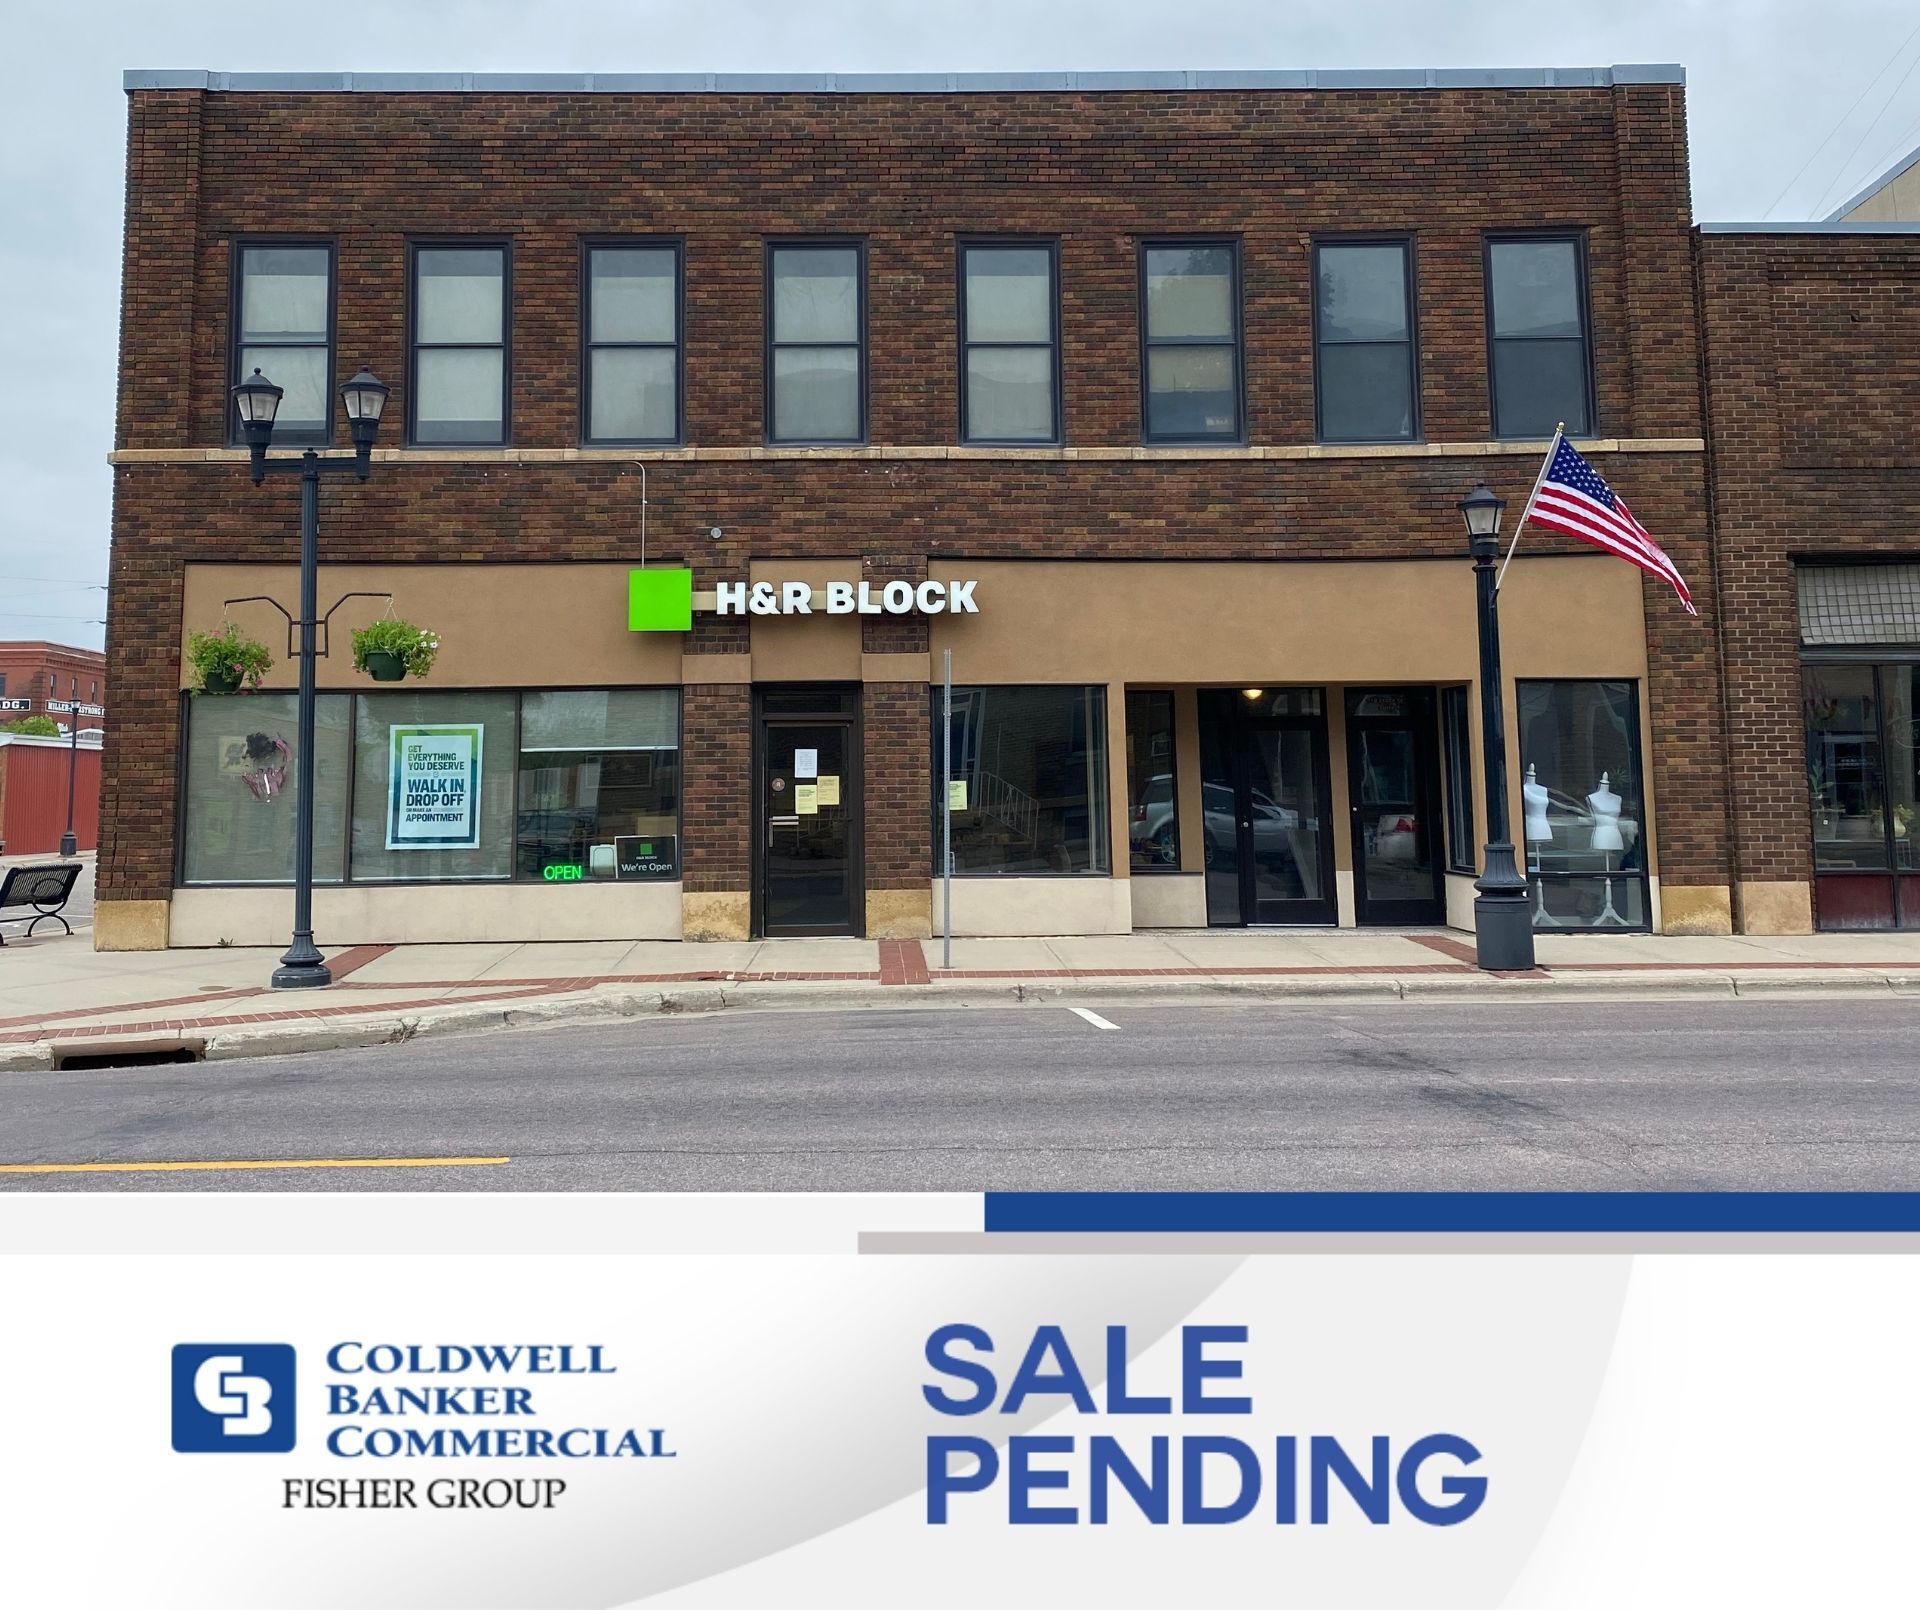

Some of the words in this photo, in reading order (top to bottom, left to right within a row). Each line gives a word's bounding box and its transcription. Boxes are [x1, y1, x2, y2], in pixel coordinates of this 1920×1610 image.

[716, 581, 813, 615] H&R
[826, 580, 980, 614] BLOCK
[0, 700, 25, 709] DG.
[408, 745, 422, 753] GET
[408, 753, 457, 761] EVERYTHING
[408, 762, 425, 770] YOU
[427, 762, 465, 770] DESERVE
[408, 779, 447, 793] WALK
[406, 794, 439, 806] DROP
[441, 794, 464, 806] OFF
[406, 813, 464, 822] APPOINTMENT
[543, 865, 582, 880] OPEN
[621, 863, 648, 872] We're
[648, 863, 673, 873] Open
